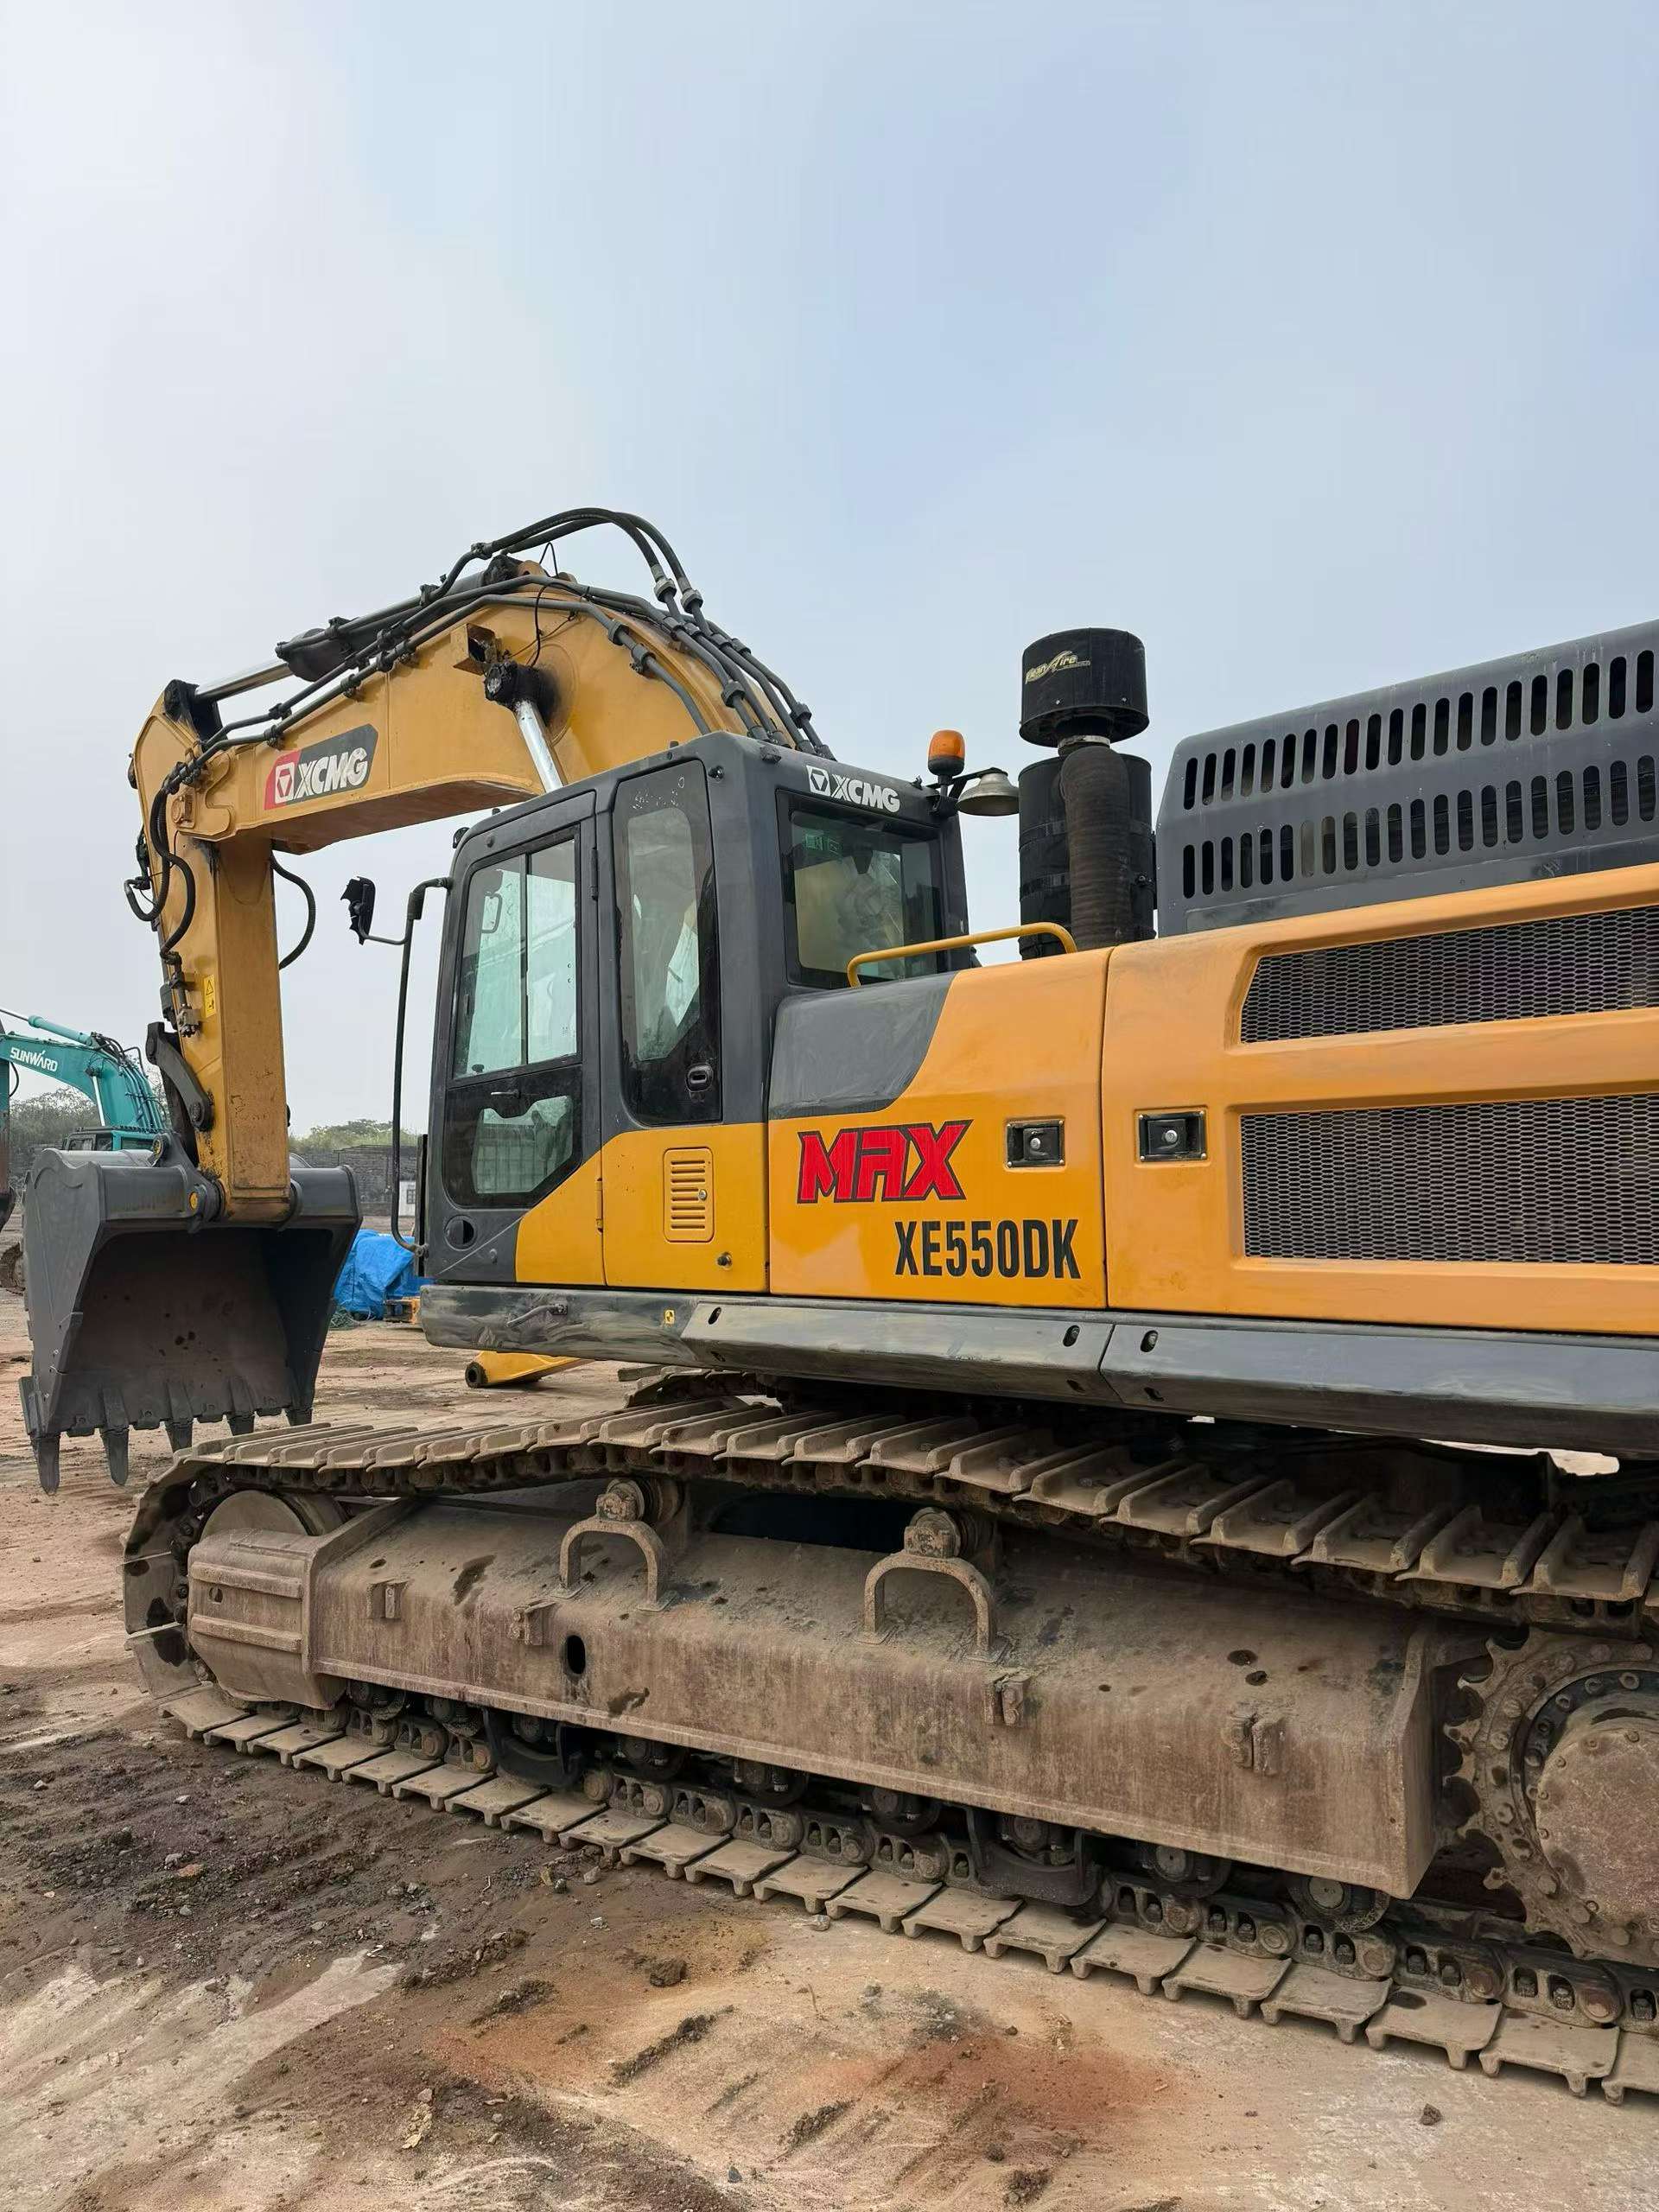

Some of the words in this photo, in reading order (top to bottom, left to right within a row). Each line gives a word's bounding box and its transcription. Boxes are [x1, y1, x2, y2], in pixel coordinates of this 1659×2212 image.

[293, 747, 368, 799] XCMG
[830, 774, 899, 813] XCMG
[10, 1046, 58, 1071] SUNWARD
[797, 1119, 974, 1204] MAX
[894, 1219, 1082, 1279] XE550DK
